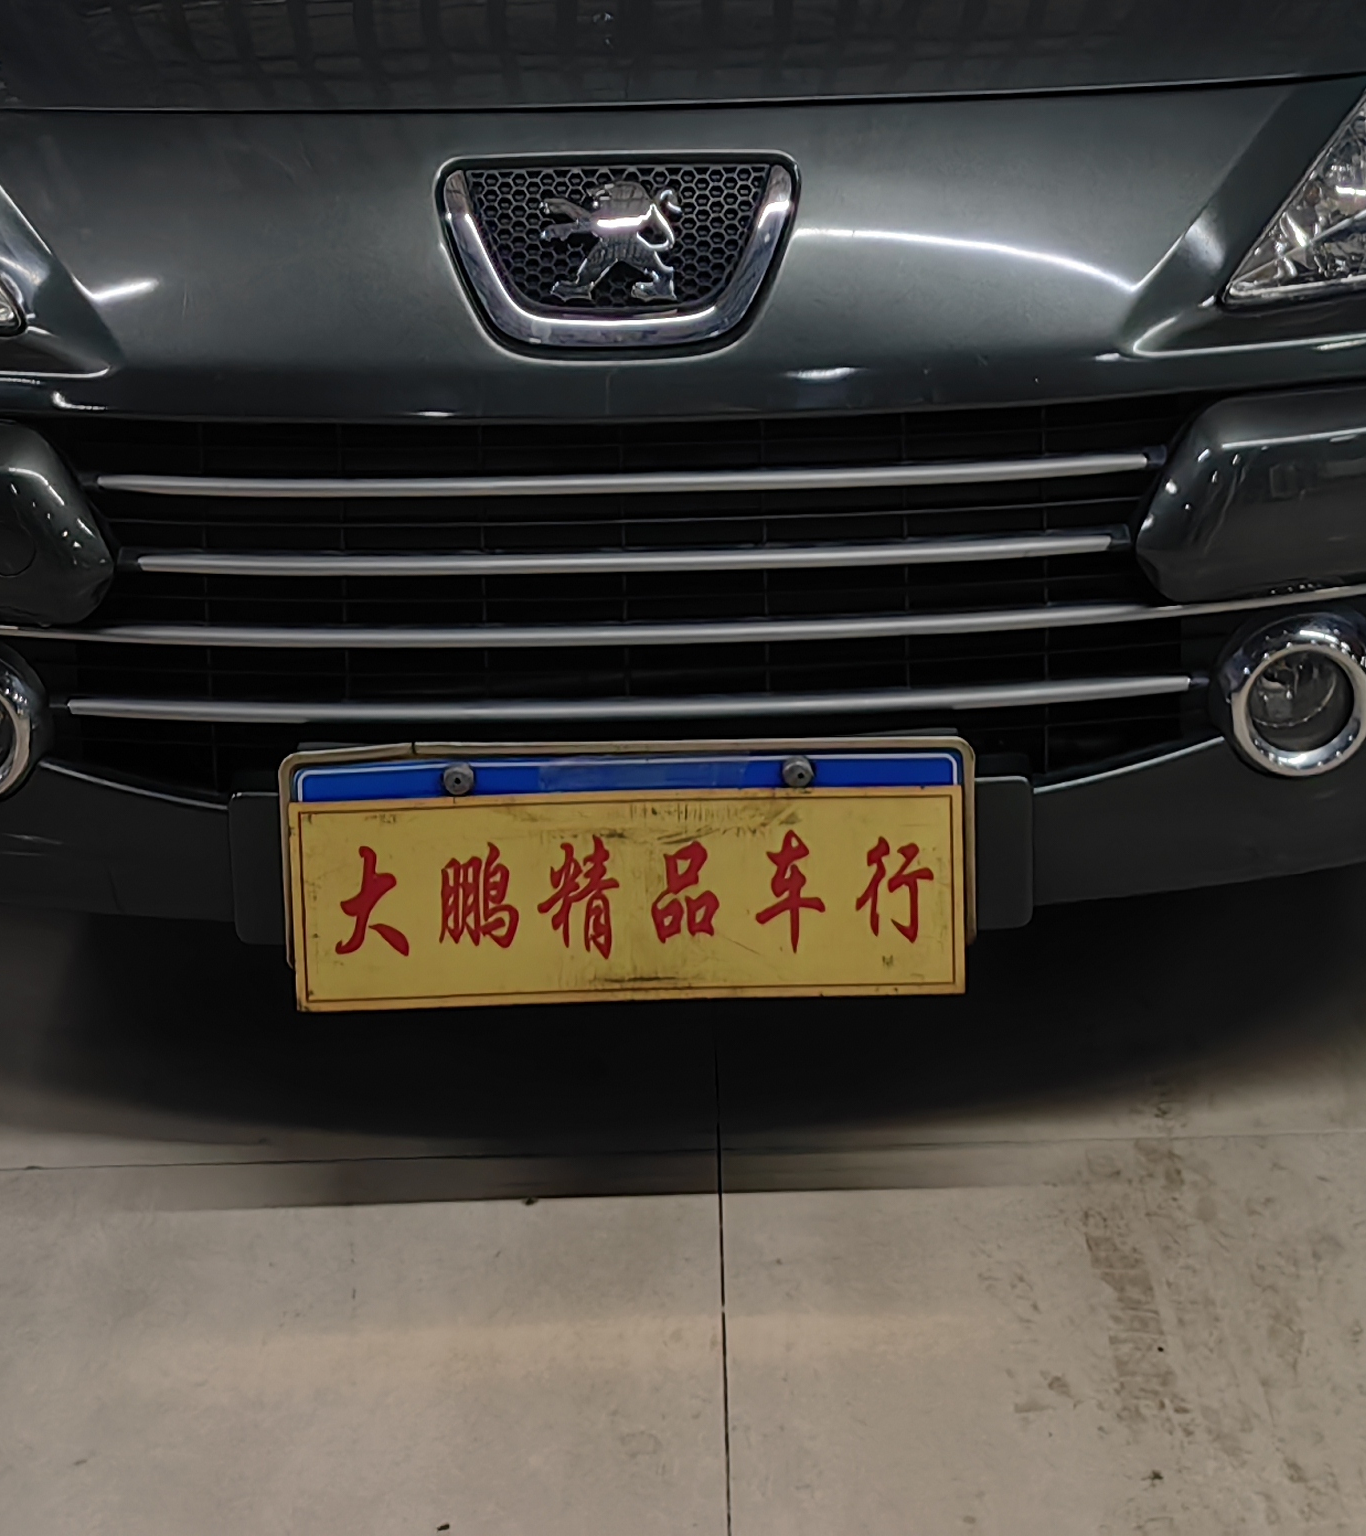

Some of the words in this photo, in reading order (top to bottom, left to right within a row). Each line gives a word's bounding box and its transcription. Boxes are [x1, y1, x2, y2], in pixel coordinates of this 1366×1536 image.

[335, 830, 934, 960] 大鹏精品车行
